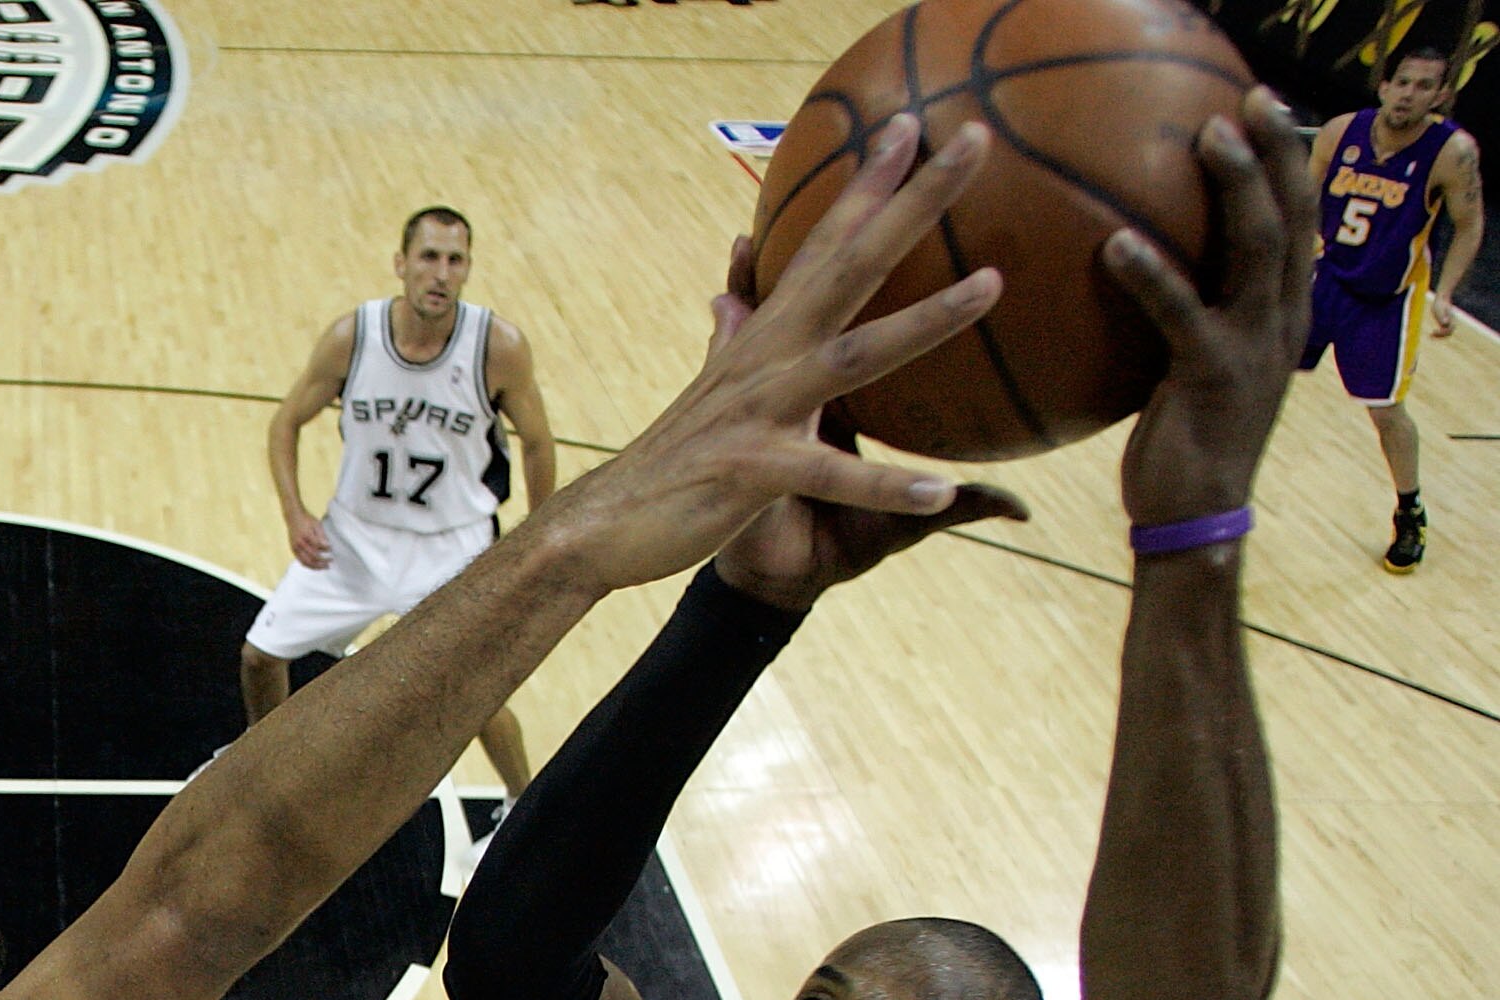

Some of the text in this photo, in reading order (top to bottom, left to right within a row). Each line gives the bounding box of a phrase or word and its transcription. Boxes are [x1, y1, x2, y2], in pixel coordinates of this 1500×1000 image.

[83, 24, 156, 149] ANTONIO
[1335, 197, 1379, 247] 5
[351, 397, 476, 437] SPURS
[371, 450, 446, 506] 17
